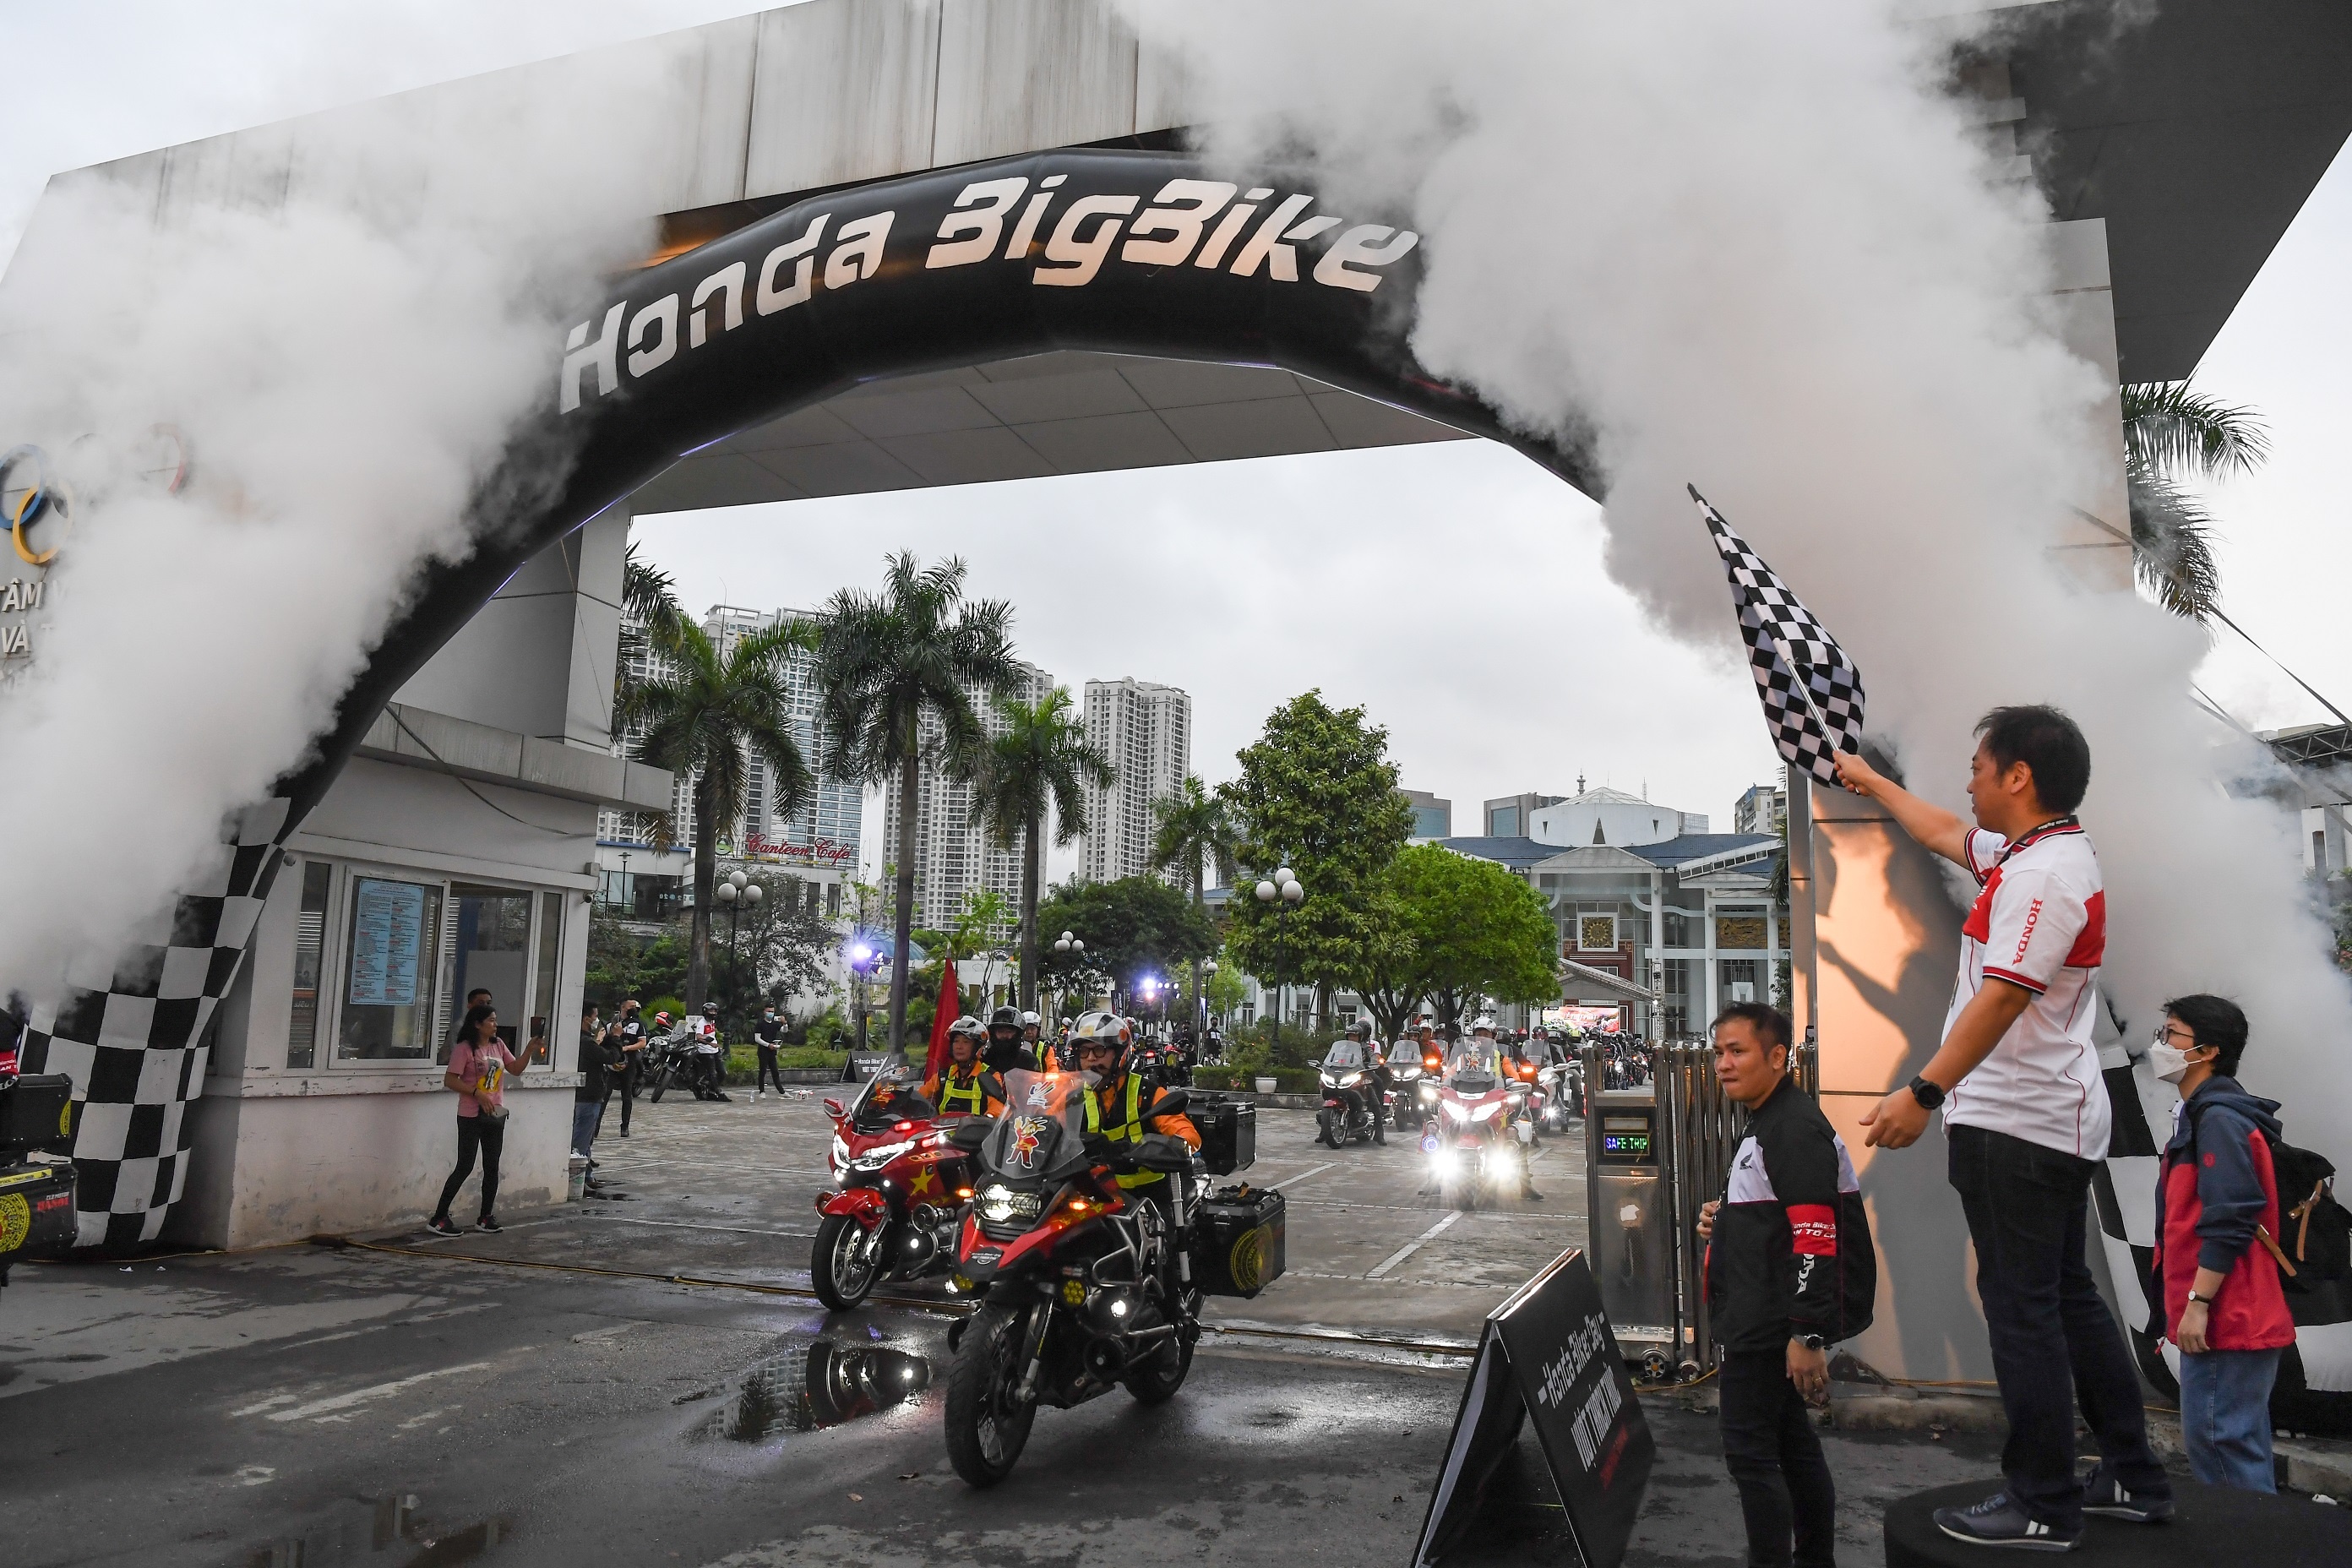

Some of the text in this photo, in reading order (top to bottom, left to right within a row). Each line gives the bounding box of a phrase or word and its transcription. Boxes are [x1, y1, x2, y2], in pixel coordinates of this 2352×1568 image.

[558, 174, 1418, 415] Honda BigBike
[2, 619, 30, 653] VÀ
[746, 832, 809, 855] Canteen
[814, 837, 853, 865] Café
[2012, 898, 2044, 966] HONDA
[1606, 1137, 1647, 1150] SAFE TRIP
[1543, 1314, 1606, 1409] Honda Biker Day
